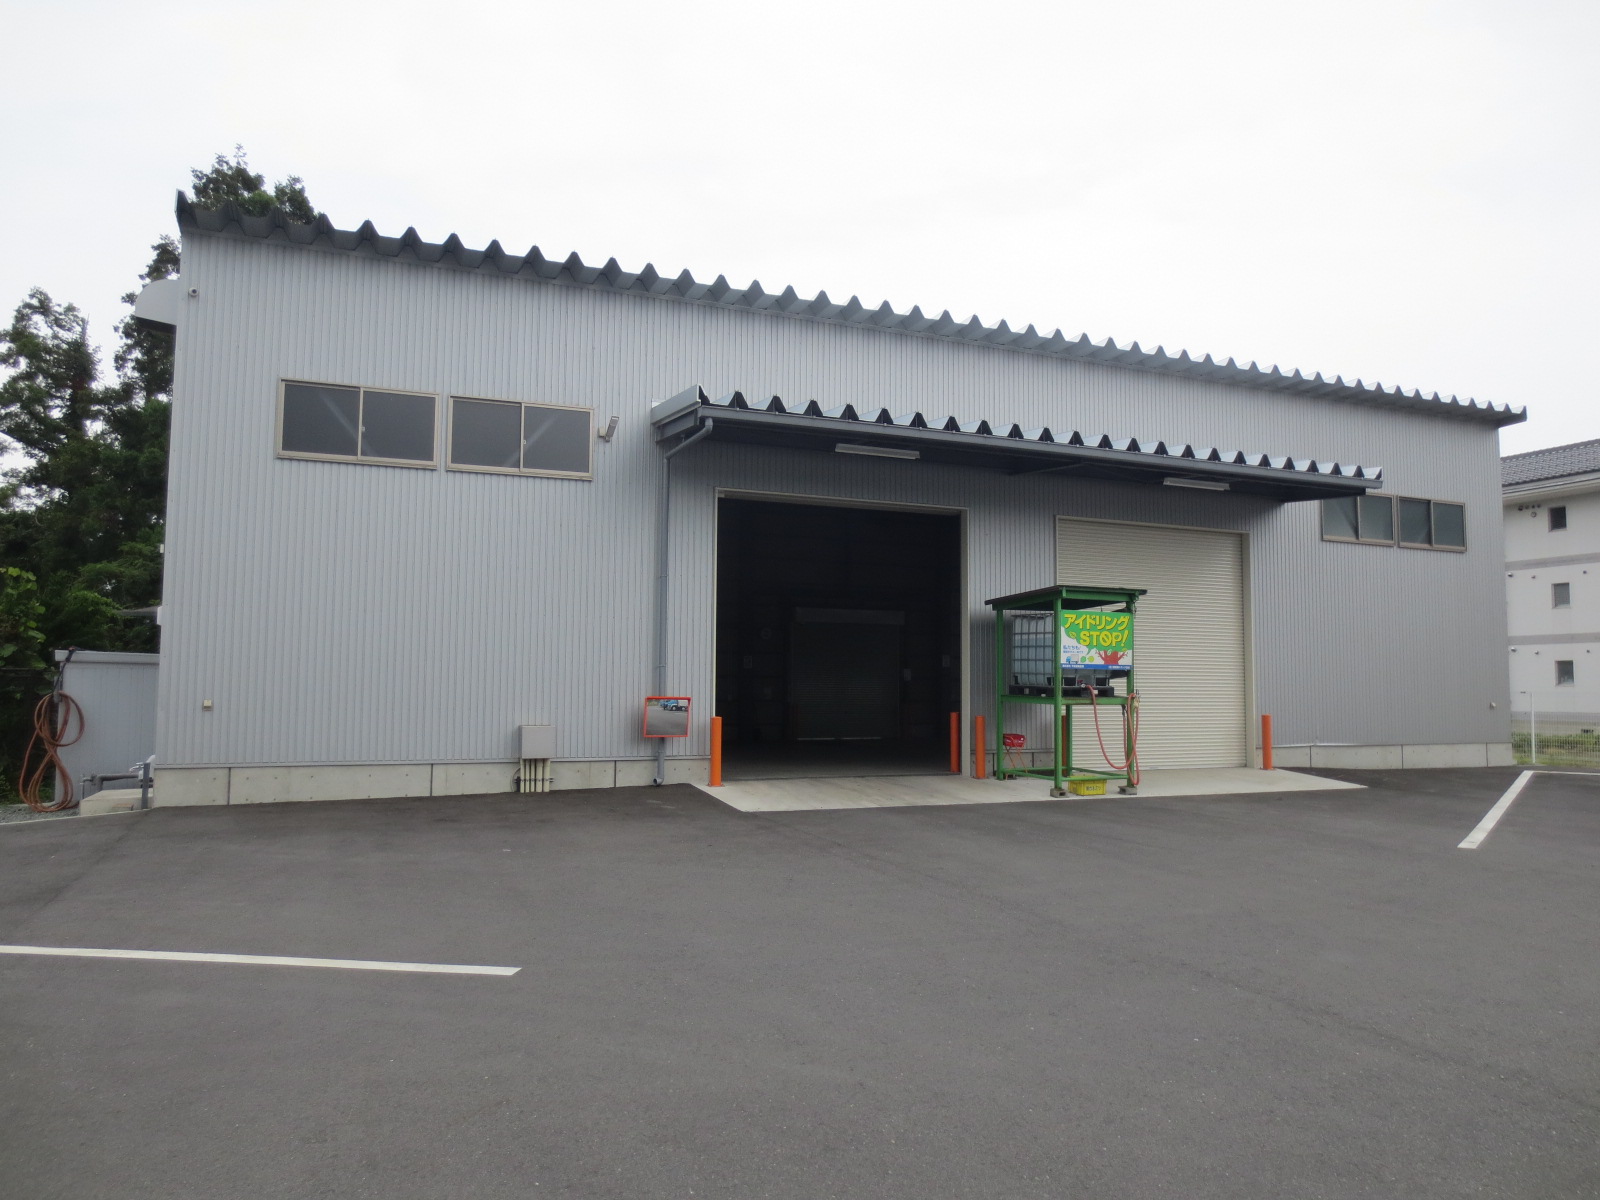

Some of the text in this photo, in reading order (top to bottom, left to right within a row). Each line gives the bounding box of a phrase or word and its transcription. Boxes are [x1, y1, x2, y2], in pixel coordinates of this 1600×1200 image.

[1064, 613, 1130, 631] アイドリング
[1080, 630, 1129, 647] STOP!
